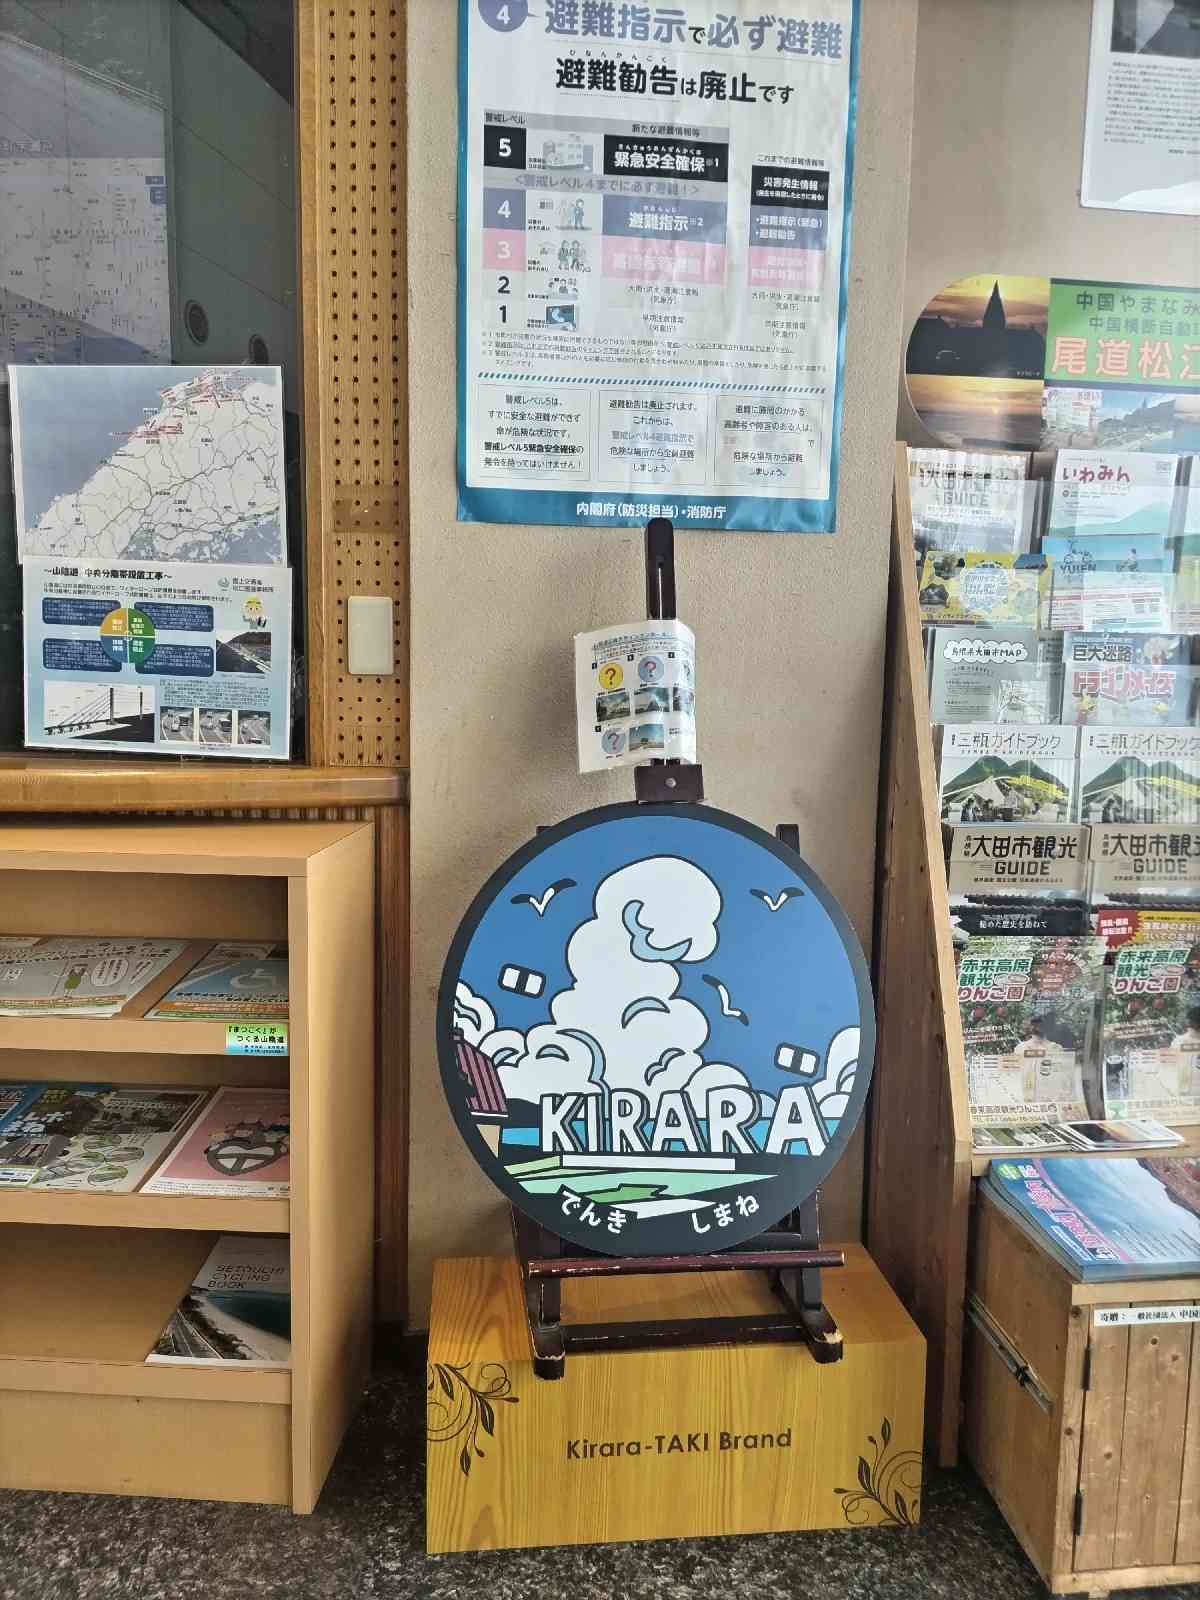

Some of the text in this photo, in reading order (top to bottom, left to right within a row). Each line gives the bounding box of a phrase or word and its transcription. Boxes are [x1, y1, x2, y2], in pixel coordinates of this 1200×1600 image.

[496, 4, 510, 24] 4
[545, 0, 844, 60] 避難指示で必ず避難
[556, 57, 794, 105] 避難勧告は廃止です
[498, 137, 512, 157] 5
[497, 200, 511, 219] 4
[497, 240, 511, 260] 3
[497, 275, 511, 295] 2
[498, 304, 507, 323] 1
[971, 834, 1077, 860] 大田市観光
[994, 860, 1051, 876] GUIDE
[1133, 858, 1188, 874] GUIDE
[959, 972, 994, 988] 観光
[1117, 963, 1148, 978] 観光
[541, 1084, 828, 1157] KIRARA
[560, 1189, 761, 1235] でんき しまね
[566, 1428, 793, 1460] Kirara-TAKI Brand
